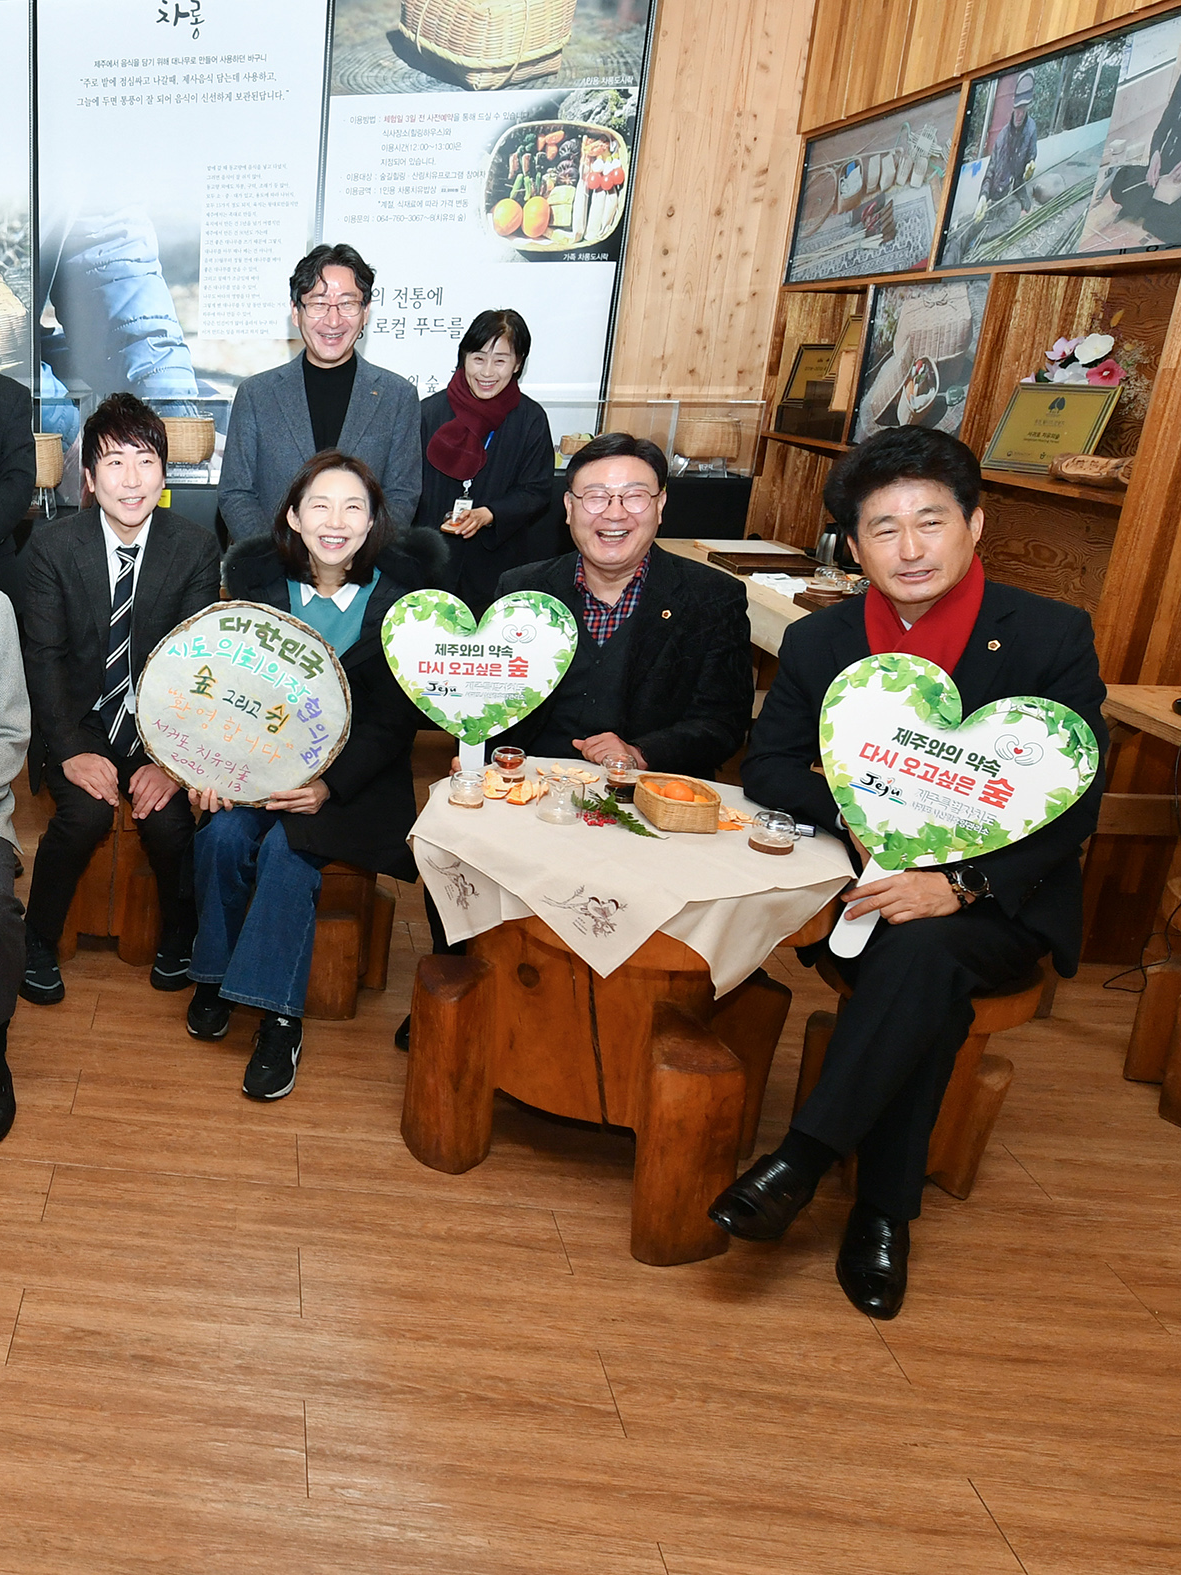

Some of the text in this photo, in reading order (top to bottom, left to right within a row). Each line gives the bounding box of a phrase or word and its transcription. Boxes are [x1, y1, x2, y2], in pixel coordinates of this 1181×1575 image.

[156, 0, 205, 39] 차롱
[94, 54, 267, 69] 제주에서 음식을 담기 위해 대나무로 만들어 사용하던 바구니
[119, 75, 150, 87] 점심싸고
[182, 73, 213, 85] 제사음식
[216, 72, 240, 84] 담는데
[77, 96, 99, 108] 그늘에
[102, 96, 117, 106] 두면
[146, 94, 154, 105] 잘
[157, 93, 172, 105] 되어
[175, 93, 198, 104] 음식이
[201, 91, 232, 103] 신선하게
[350, 116, 376, 124] 이용방법
[384, 114, 403, 124] 체험일
[405, 114, 416, 123] 3일
[419, 114, 425, 122] 전
[427, 113, 459, 122] 사전예약을
[463, 113, 476, 121] 통해
[478, 112, 491, 120] 드실
[381, 158, 406, 166] 지정되어
[347, 173, 372, 182] 이용대상
[346, 187, 372, 195] 이용금액
[425, 200, 438, 208] 따라
[441, 199, 453, 208] 가격
[456, 199, 468, 208] 변동
[344, 215, 369, 223] 이용문의
[393, 287, 443, 309] 전통에
[373, 317, 406, 339] 로컬
[413, 317, 464, 339] 푸드를
[425, 375, 439, 393] 숲
[219, 617, 324, 680] 대한민국
[435, 644, 513, 658] 제주와의 약속
[168, 637, 311, 704] 시도의회의장
[419, 657, 529, 678] 다시 오고싶은 숲
[426, 682, 457, 696] Jeju
[189, 665, 291, 734] 숲 그리고 쉼
[152, 719, 189, 751] 서귀포
[891, 727, 1001, 778] 제주와의 약속
[859, 742, 1016, 810] 다시 오고싶은 숲
[859, 773, 904, 797] Jeju
